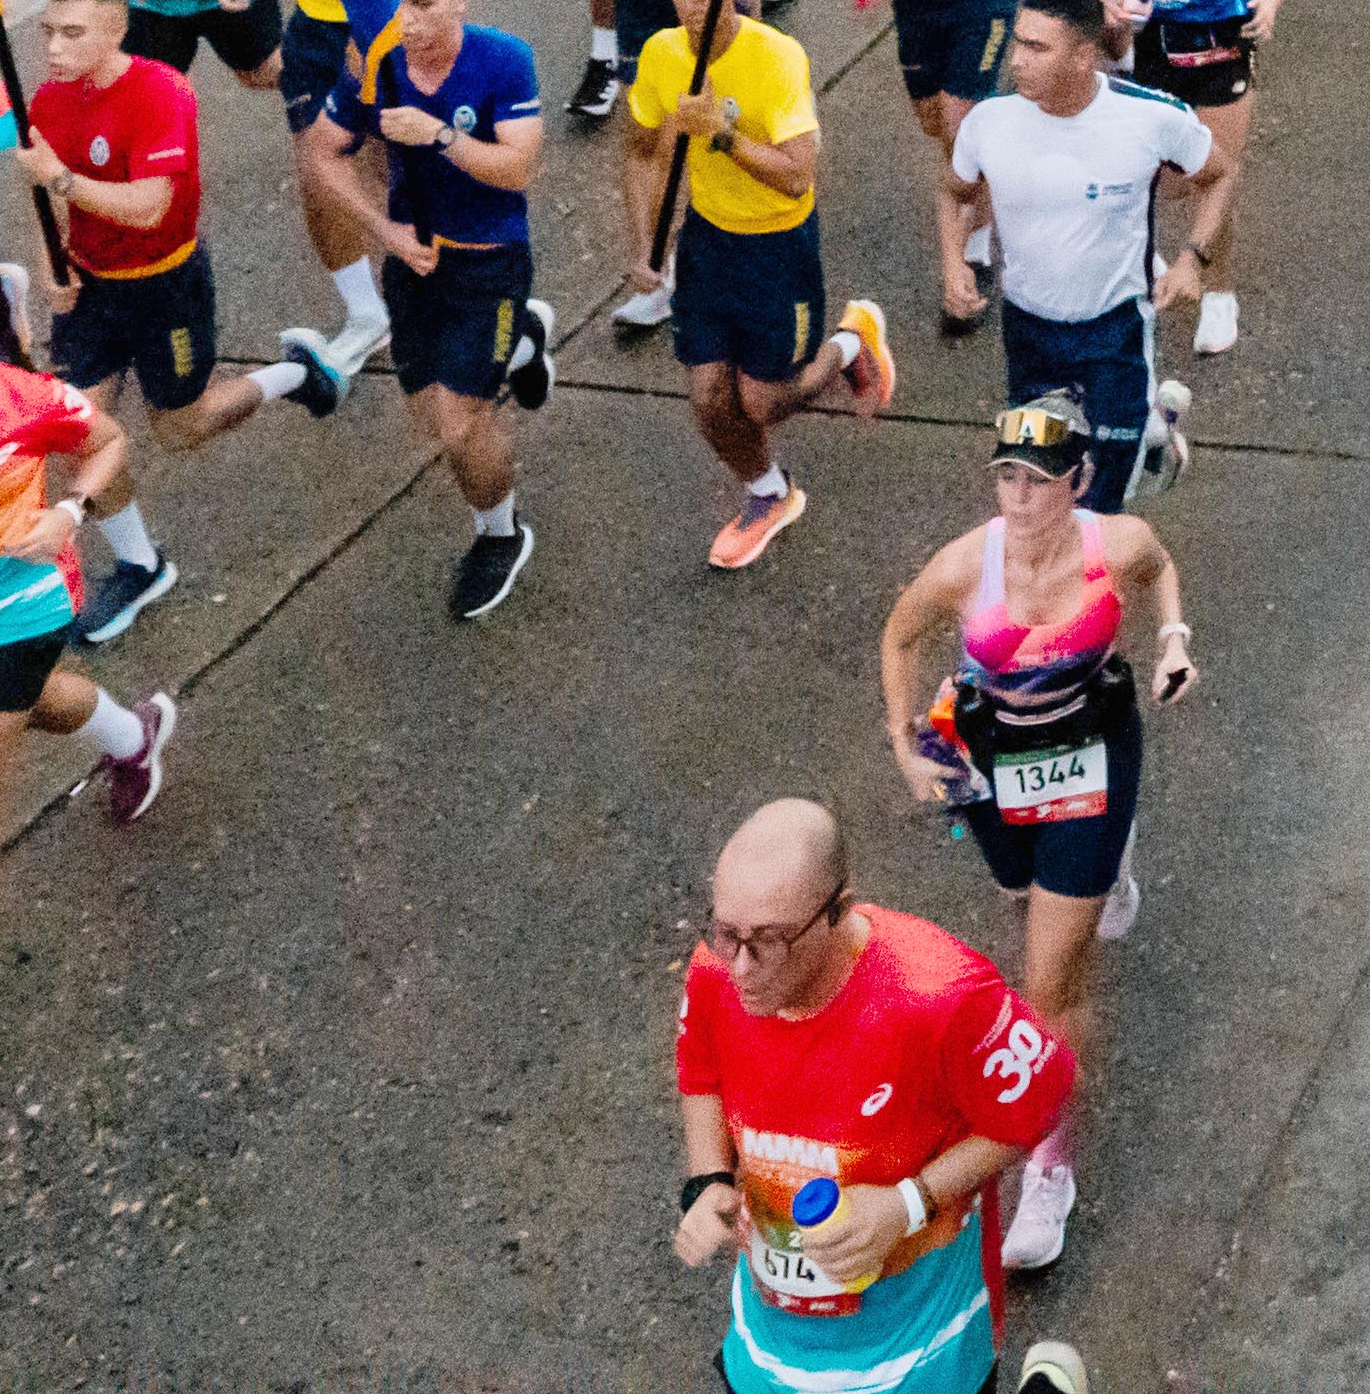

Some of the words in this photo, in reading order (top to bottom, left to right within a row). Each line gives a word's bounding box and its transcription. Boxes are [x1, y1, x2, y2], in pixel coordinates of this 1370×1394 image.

[1014, 754, 1086, 794] 1344
[983, 1019, 1043, 1104] 30
[763, 1249, 816, 1282] 674
